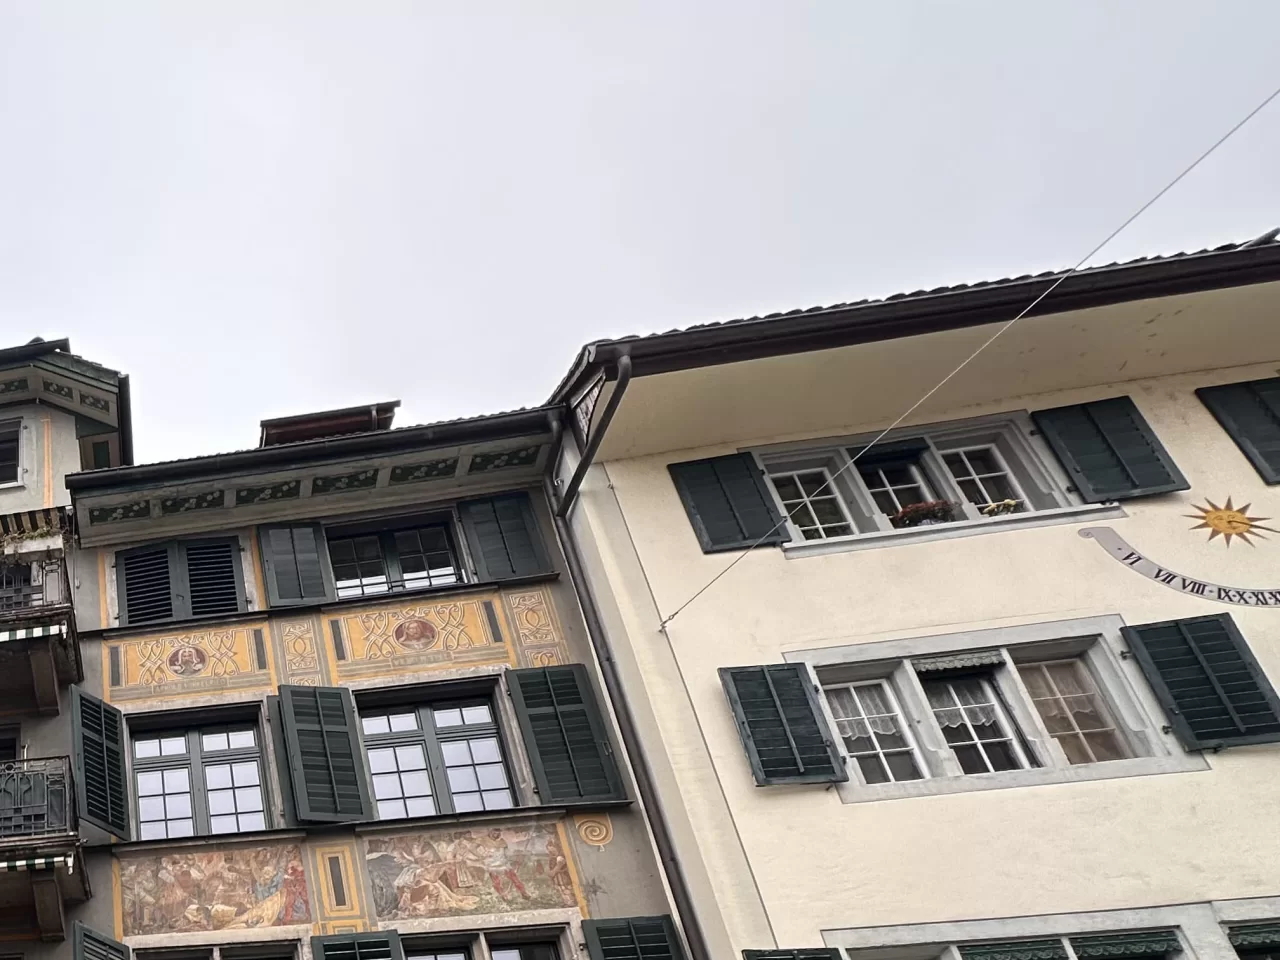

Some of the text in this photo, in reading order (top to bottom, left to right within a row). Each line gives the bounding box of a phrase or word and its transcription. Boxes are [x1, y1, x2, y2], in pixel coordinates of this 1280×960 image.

[1122, 551, 1143, 566] VI
[1153, 567, 1179, 585] VII
[1180, 577, 1209, 596] VIII
